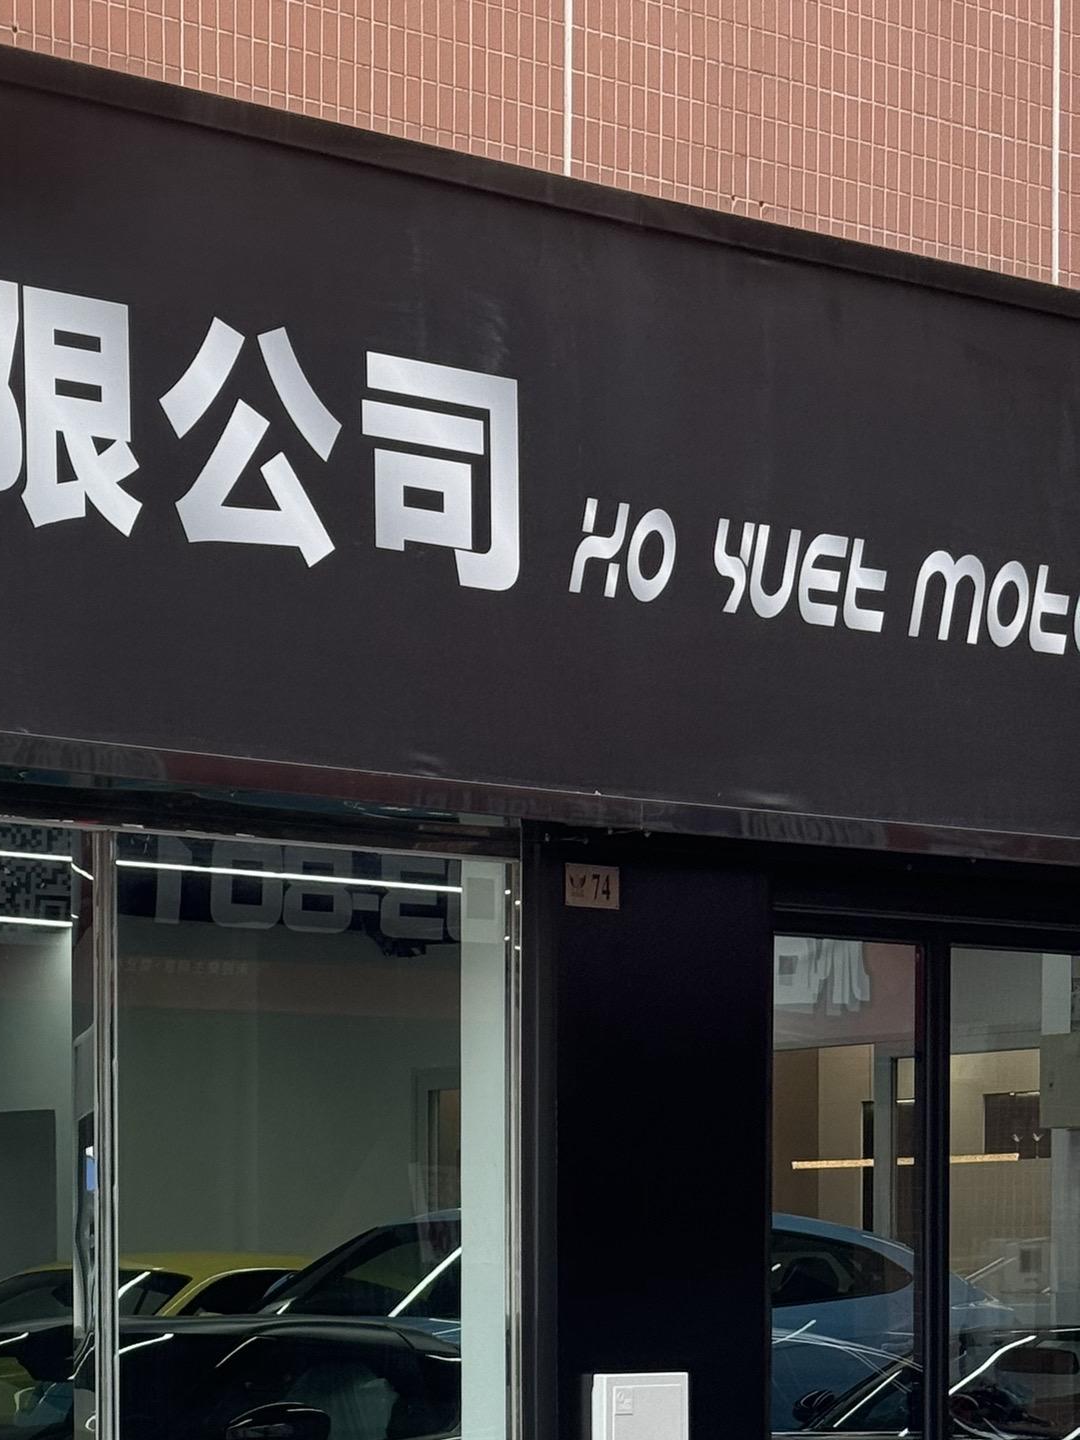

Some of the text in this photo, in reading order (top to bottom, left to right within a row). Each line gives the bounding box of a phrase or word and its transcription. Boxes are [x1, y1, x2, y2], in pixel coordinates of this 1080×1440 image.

[568, 496, 678, 604] HO
[907, 549, 1080, 656] MOT
[591, 873, 611, 901] 74
